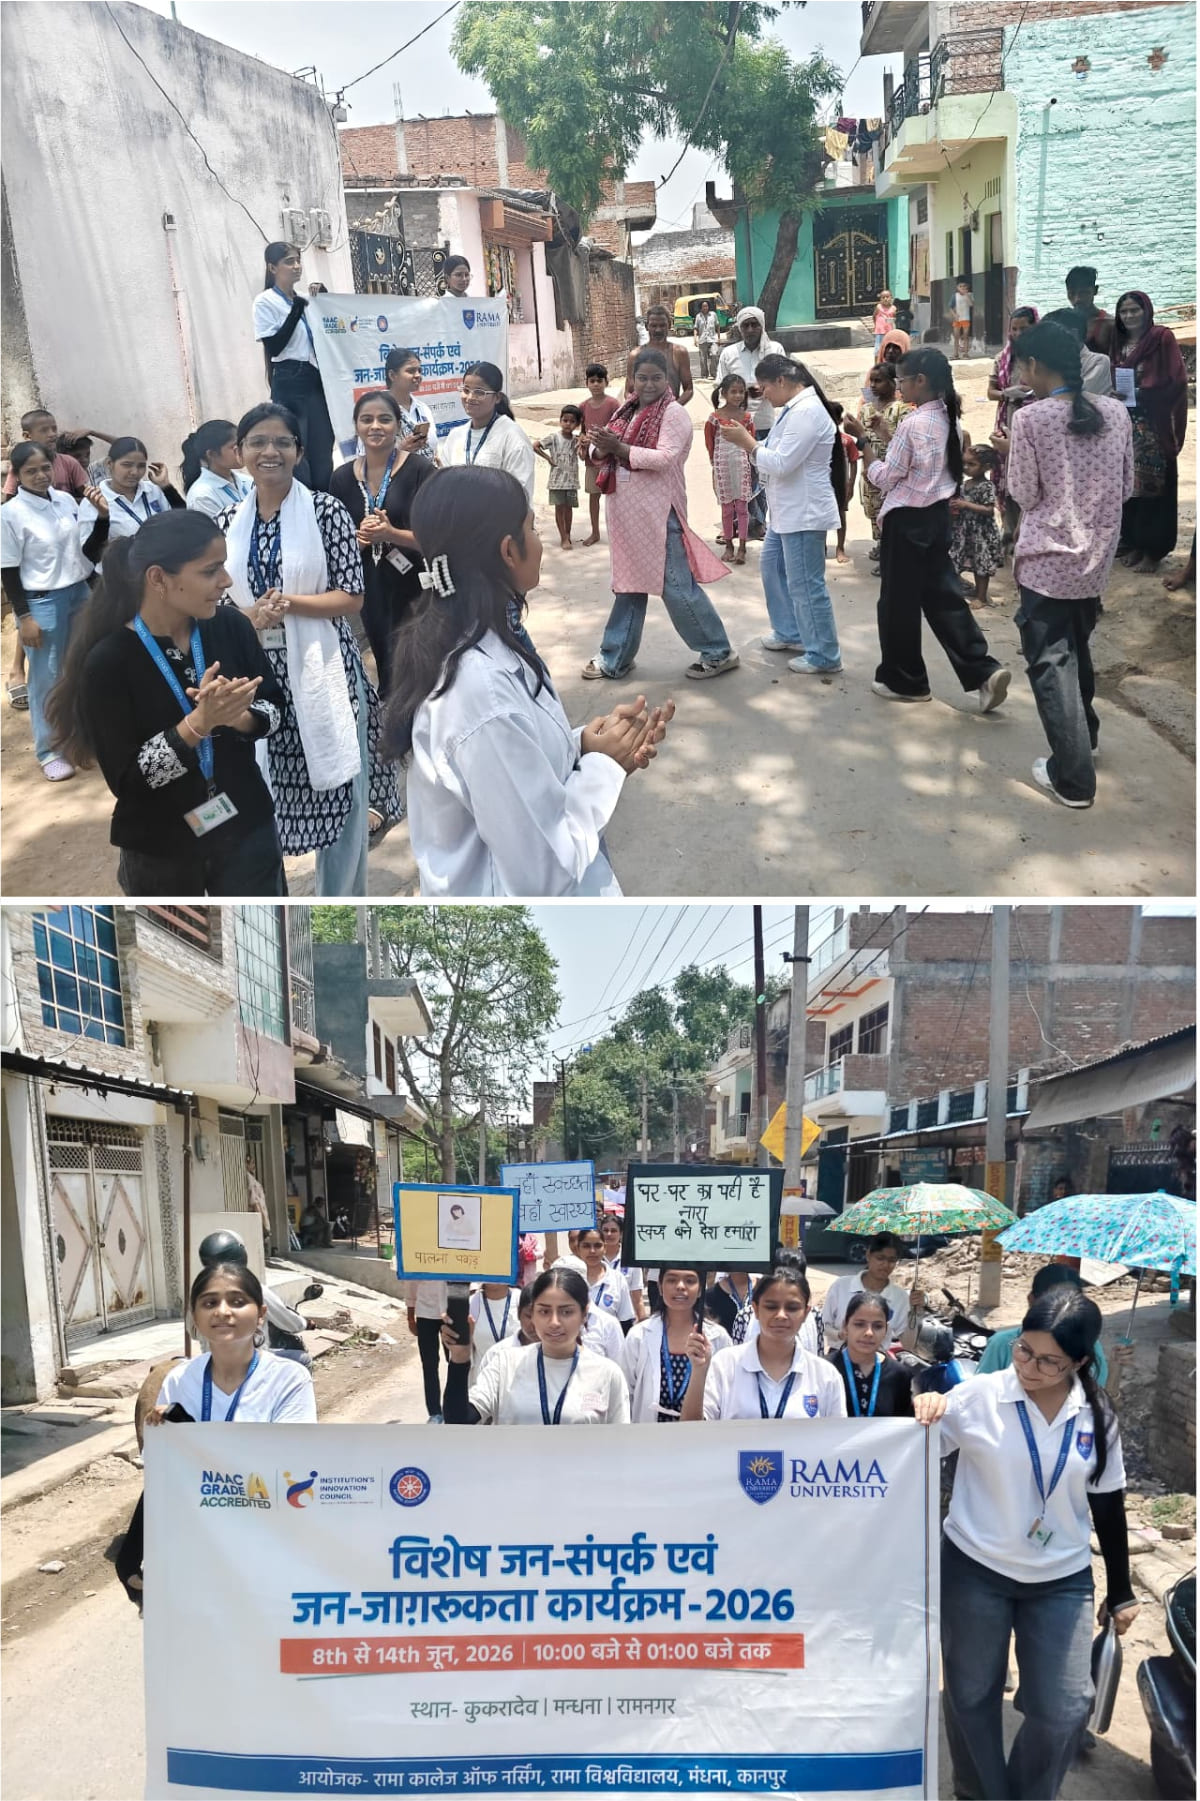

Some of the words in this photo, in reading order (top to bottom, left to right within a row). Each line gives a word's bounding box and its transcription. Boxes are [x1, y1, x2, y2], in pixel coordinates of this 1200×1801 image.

[446, 341, 462, 357] एवं
[749, 1176, 765, 1199] है
[679, 1205, 709, 1222] नारा
[202, 1470, 244, 1485] NAAC
[320, 1476, 375, 1484] INSTITUTION'S
[789, 1459, 888, 1484] RAMA
[200, 1484, 246, 1497] GRADE
[247, 1472, 270, 1500] A
[790, 1485, 888, 1498] UNIVERSITY
[200, 1497, 271, 1510] ACCREDITED
[388, 1534, 492, 1579] विशेष
[498, 1532, 657, 1578] जन-संपर्क
[664, 1533, 719, 1576] एवं
[312, 1647, 347, 1665] 8th
[353, 1641, 371, 1664] से
[375, 1645, 420, 1664] 14th
[426, 1645, 460, 1670] जून,
[466, 1644, 513, 1662] 2026
[532, 1643, 586, 1662] 10:00
[591, 1637, 622, 1660] बजे
[626, 1637, 643, 1660] से
[647, 1642, 698, 1659] 01:00
[704, 1637, 735, 1660] बजे
[738, 1642, 772, 1659] तक
[409, 1701, 458, 1719] स्थान-
[464, 1695, 539, 1724] कुकरादेव
[553, 1698, 603, 1715] मन्धना
[616, 1698, 677, 1715] रामनगर
[298, 1767, 369, 1787] आयोजक-
[373, 1772, 405, 1787] रामा
[408, 1767, 457, 1787] कालेज
[462, 1766, 498, 1786] ऑफ
[501, 1763, 546, 1787] नर्सिंग,
[551, 1769, 581, 1785] रामा
[585, 1764, 683, 1787] विश्वविद्यालय,
[688, 1765, 733, 1787] मंधना,
[736, 1769, 787, 1790] कानपुर
